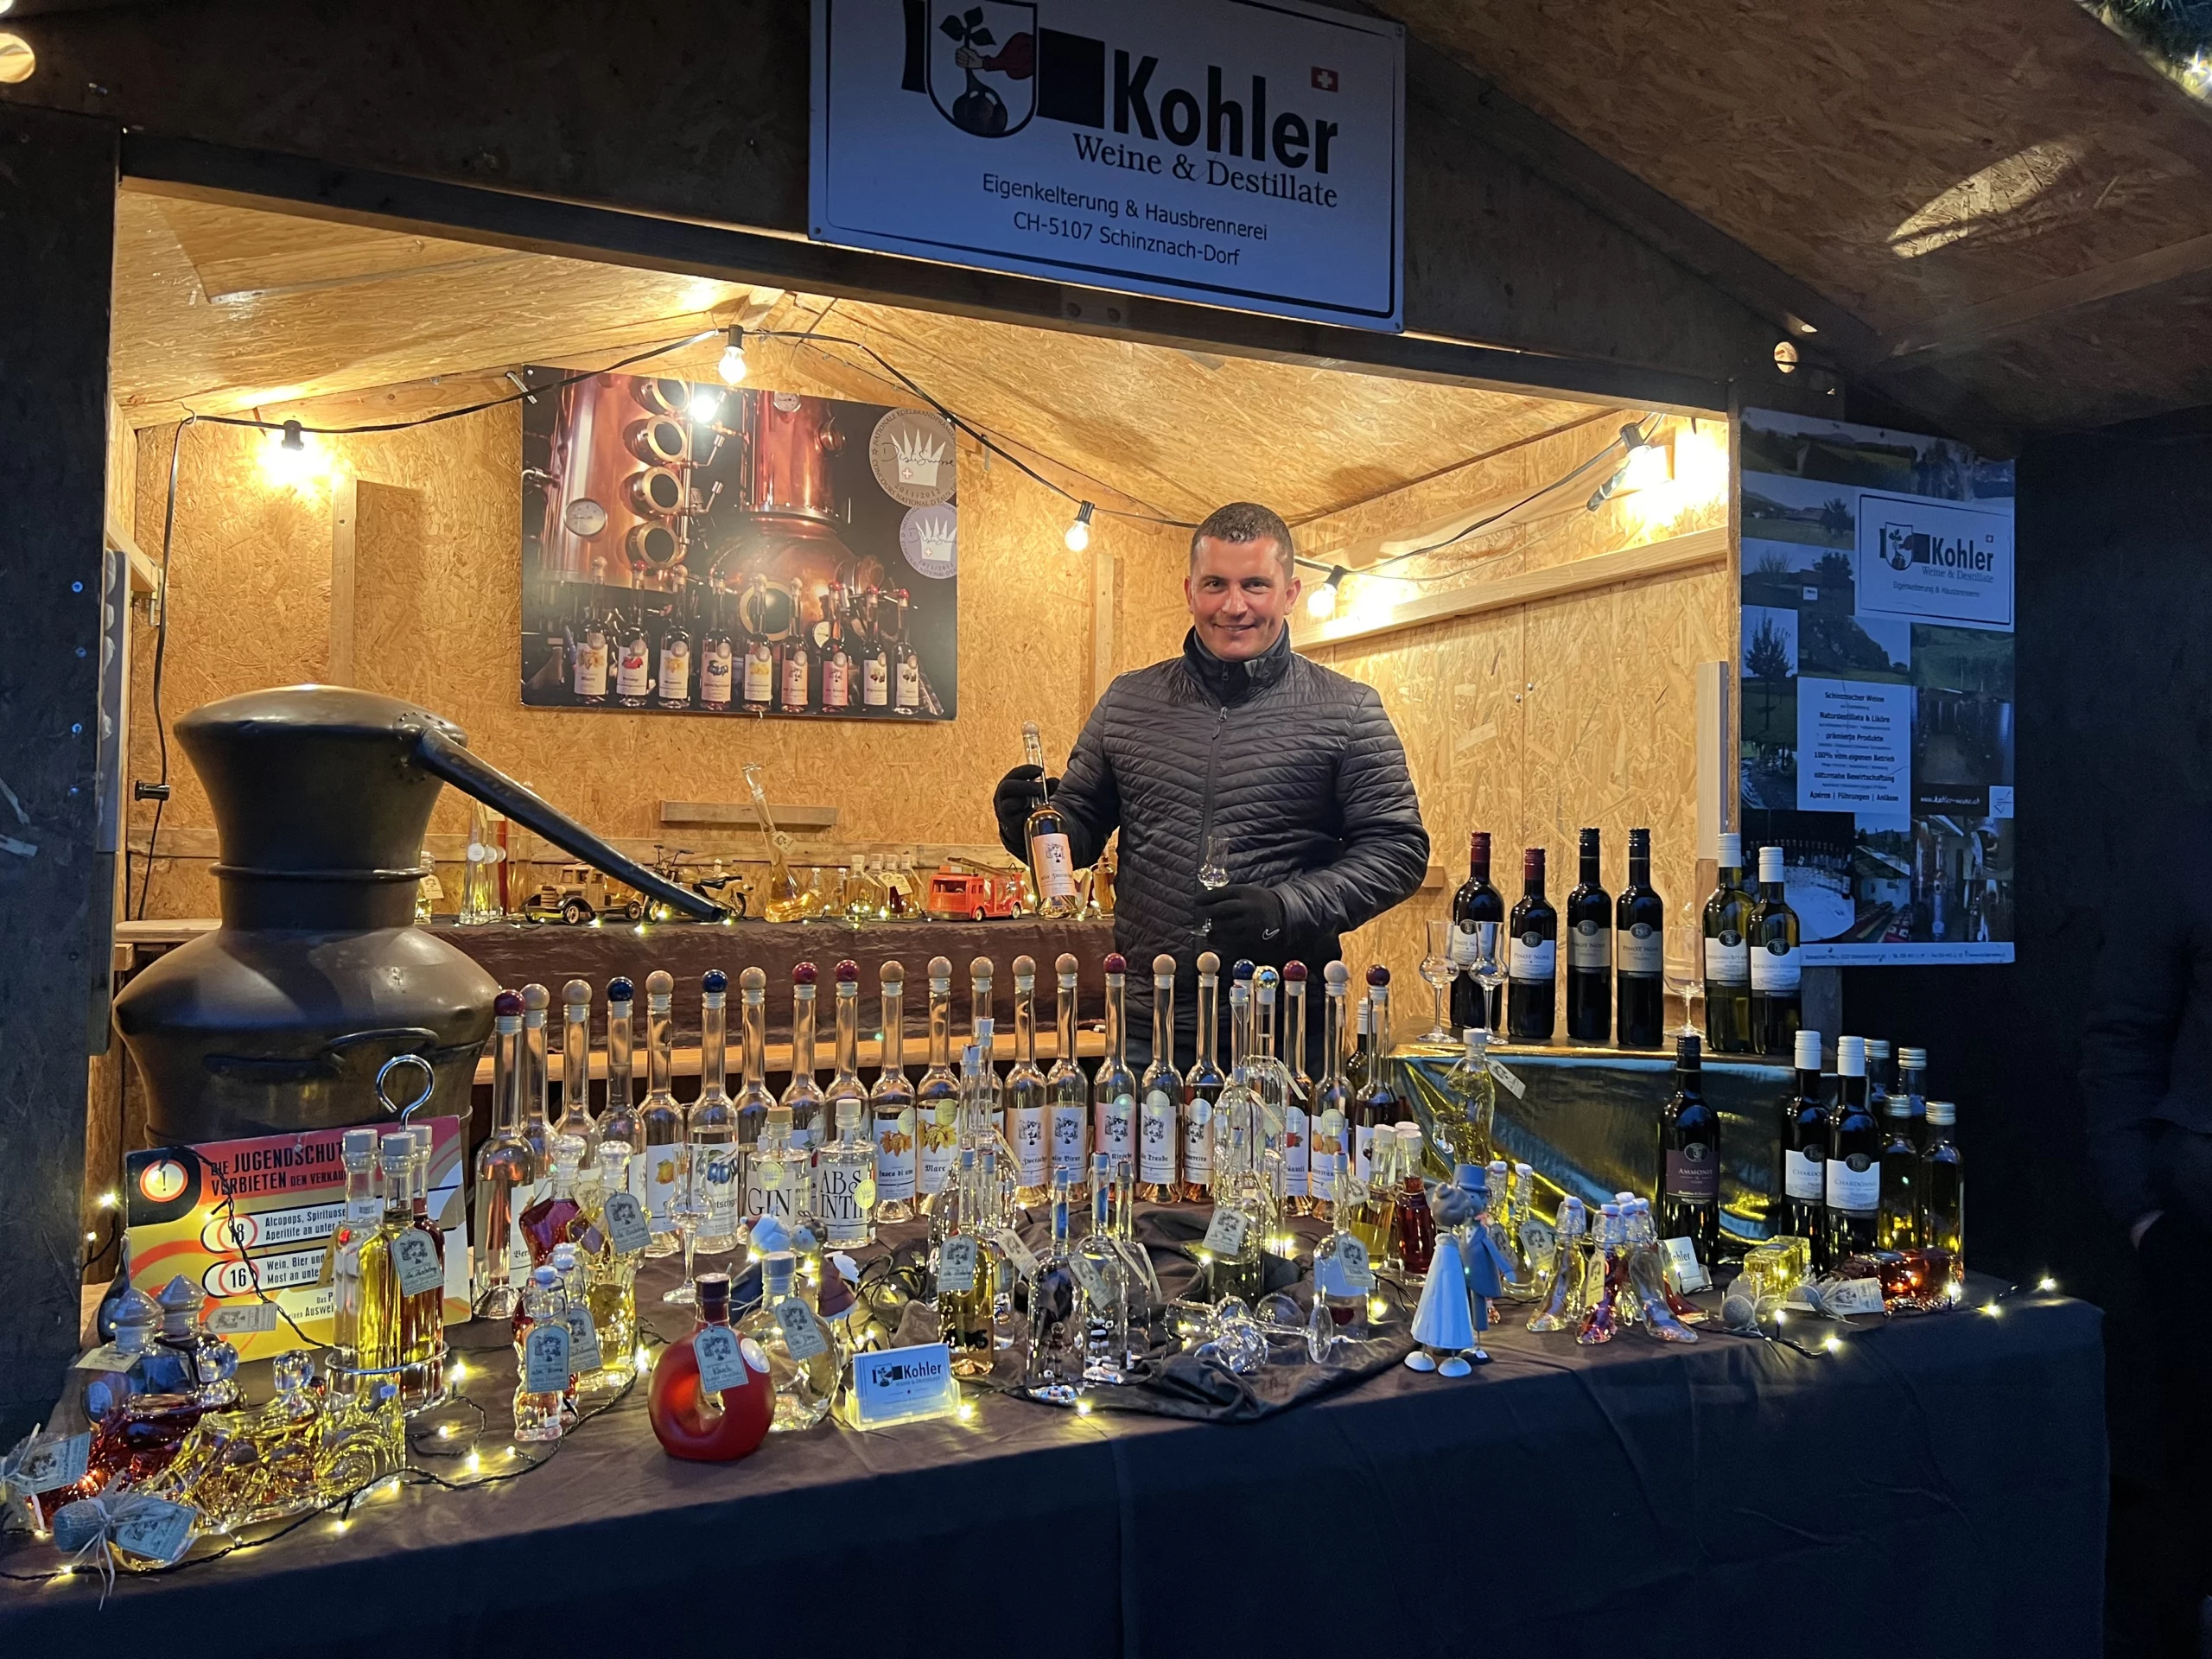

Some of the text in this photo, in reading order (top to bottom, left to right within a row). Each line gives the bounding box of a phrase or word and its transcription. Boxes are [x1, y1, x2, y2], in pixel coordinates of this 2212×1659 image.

[1114, 48, 1338, 174] Kohler
[1073, 133, 1338, 208] Weine & Destillate
[983, 174, 1268, 240] Eigenkelterung & Hausbrennerei
[1014, 211, 1240, 265] CH-5107 Schinznach-Dorf
[872, 460, 895, 496] CONCOURS
[896, 493, 930, 506] NATIONAL
[1932, 537, 1993, 571] Kohler
[291, 1175, 307, 1186] DEN
[748, 1188, 791, 1216] GIN
[266, 1229, 300, 1241] Aperitife
[303, 1226, 312, 1235] an
[315, 1223, 334, 1233] unter
[231, 1268, 246, 1287] 16
[267, 1261, 289, 1271] Wein,
[292, 1256, 308, 1268] Bier
[268, 1274, 287, 1284] Most
[290, 1272, 299, 1281] an
[904, 1361, 941, 1379] Kohler
